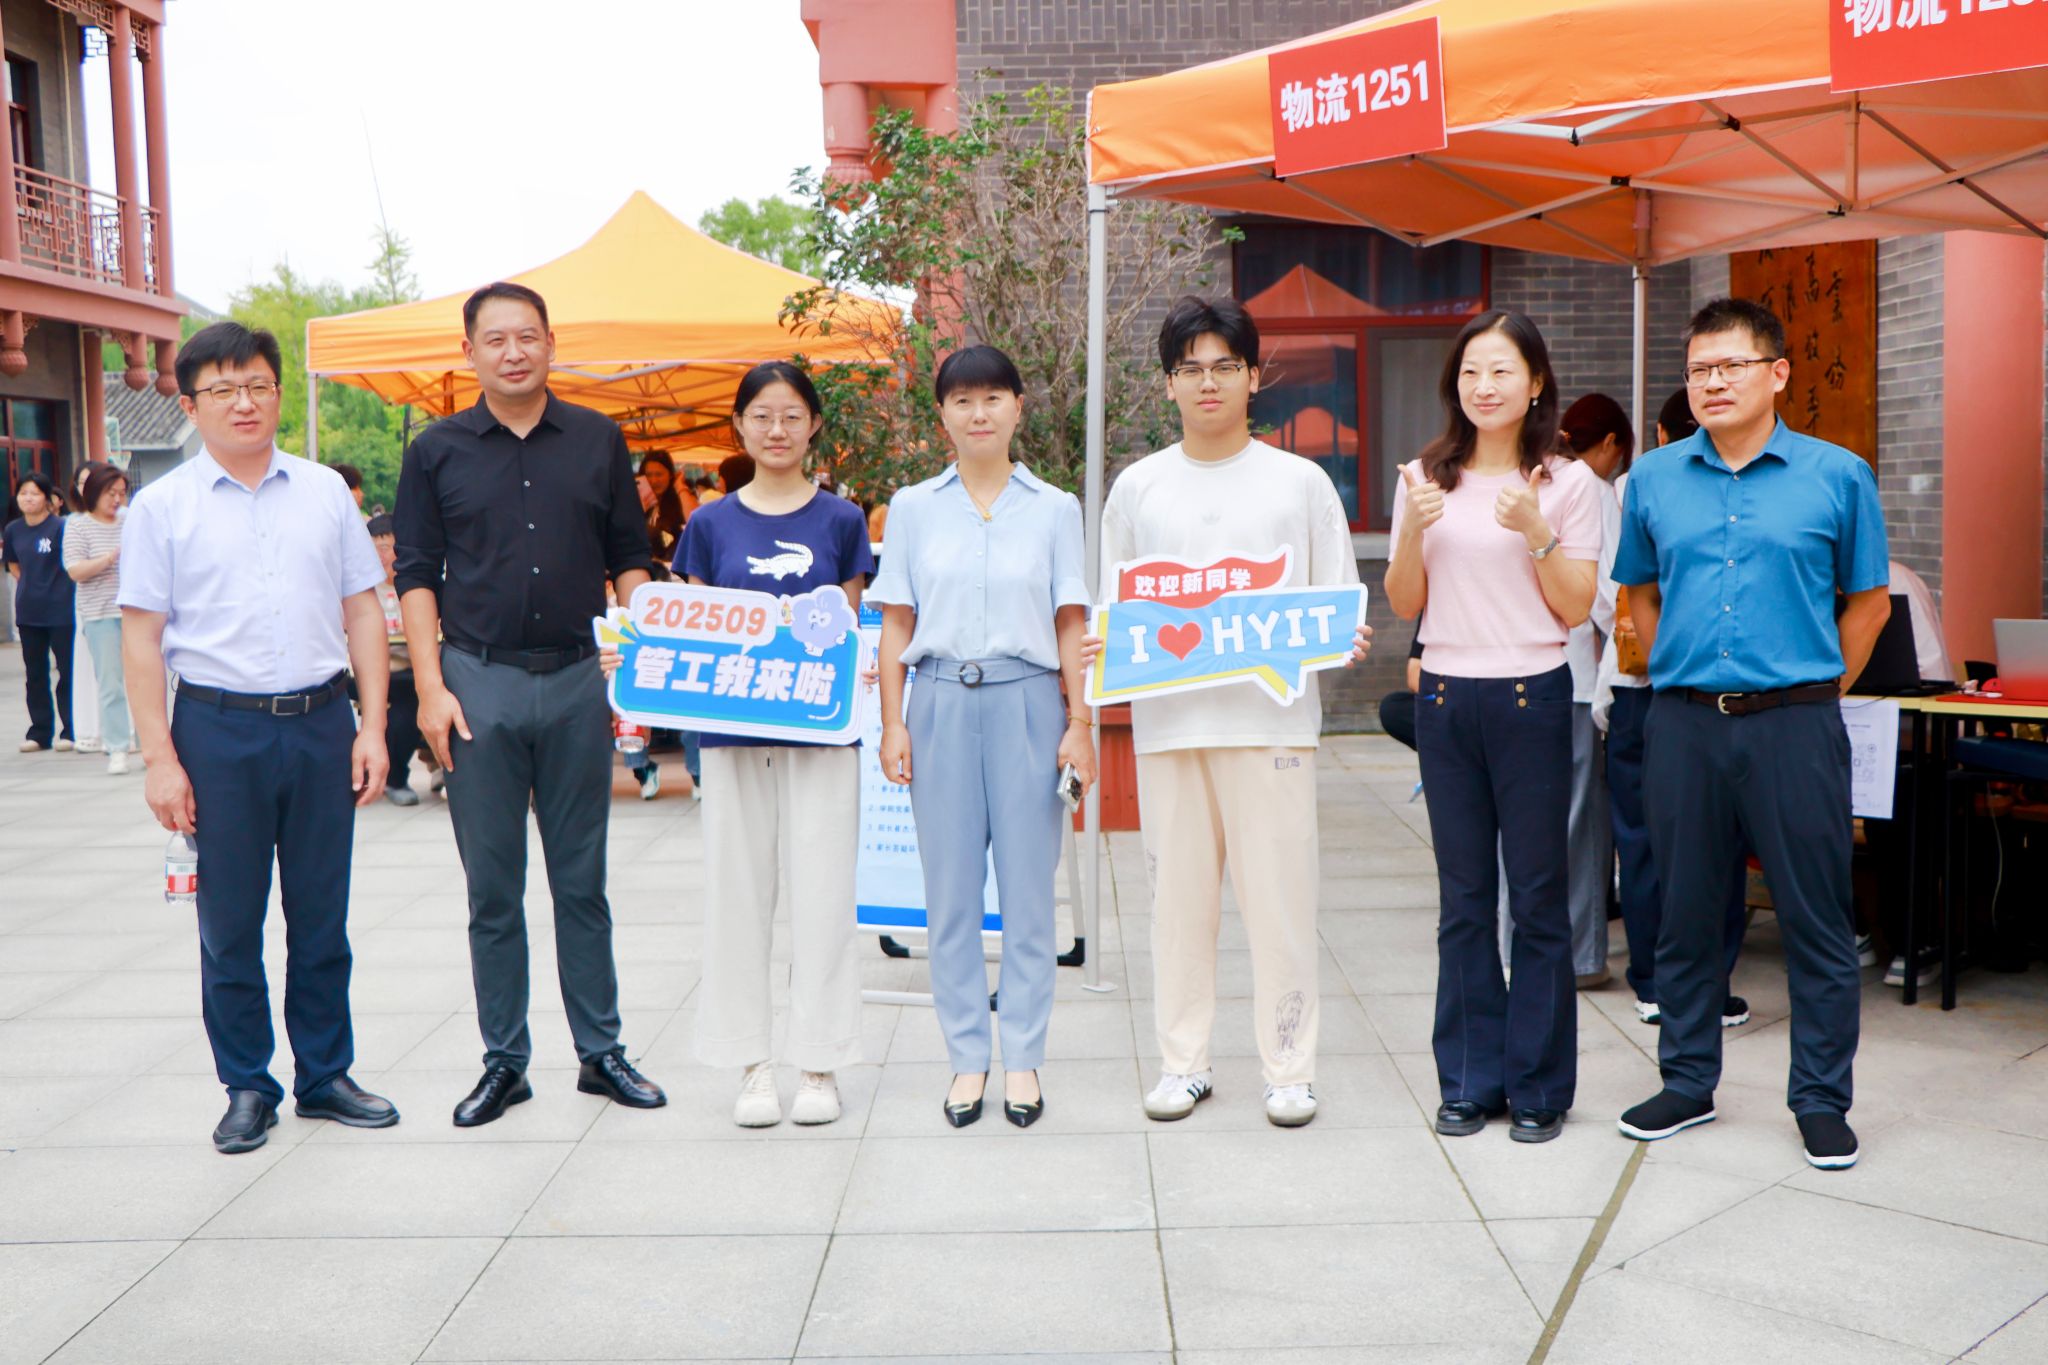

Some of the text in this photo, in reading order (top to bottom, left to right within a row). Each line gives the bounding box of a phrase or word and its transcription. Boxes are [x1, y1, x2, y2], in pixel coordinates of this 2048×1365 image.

[1280, 59, 1429, 133] 物流1251
[1134, 567, 1252, 598] 欢迎新同学
[643, 596, 767, 637] 202509
[1128, 604, 1337, 664] I HYIT
[633, 645, 837, 706] 管工我来啦
